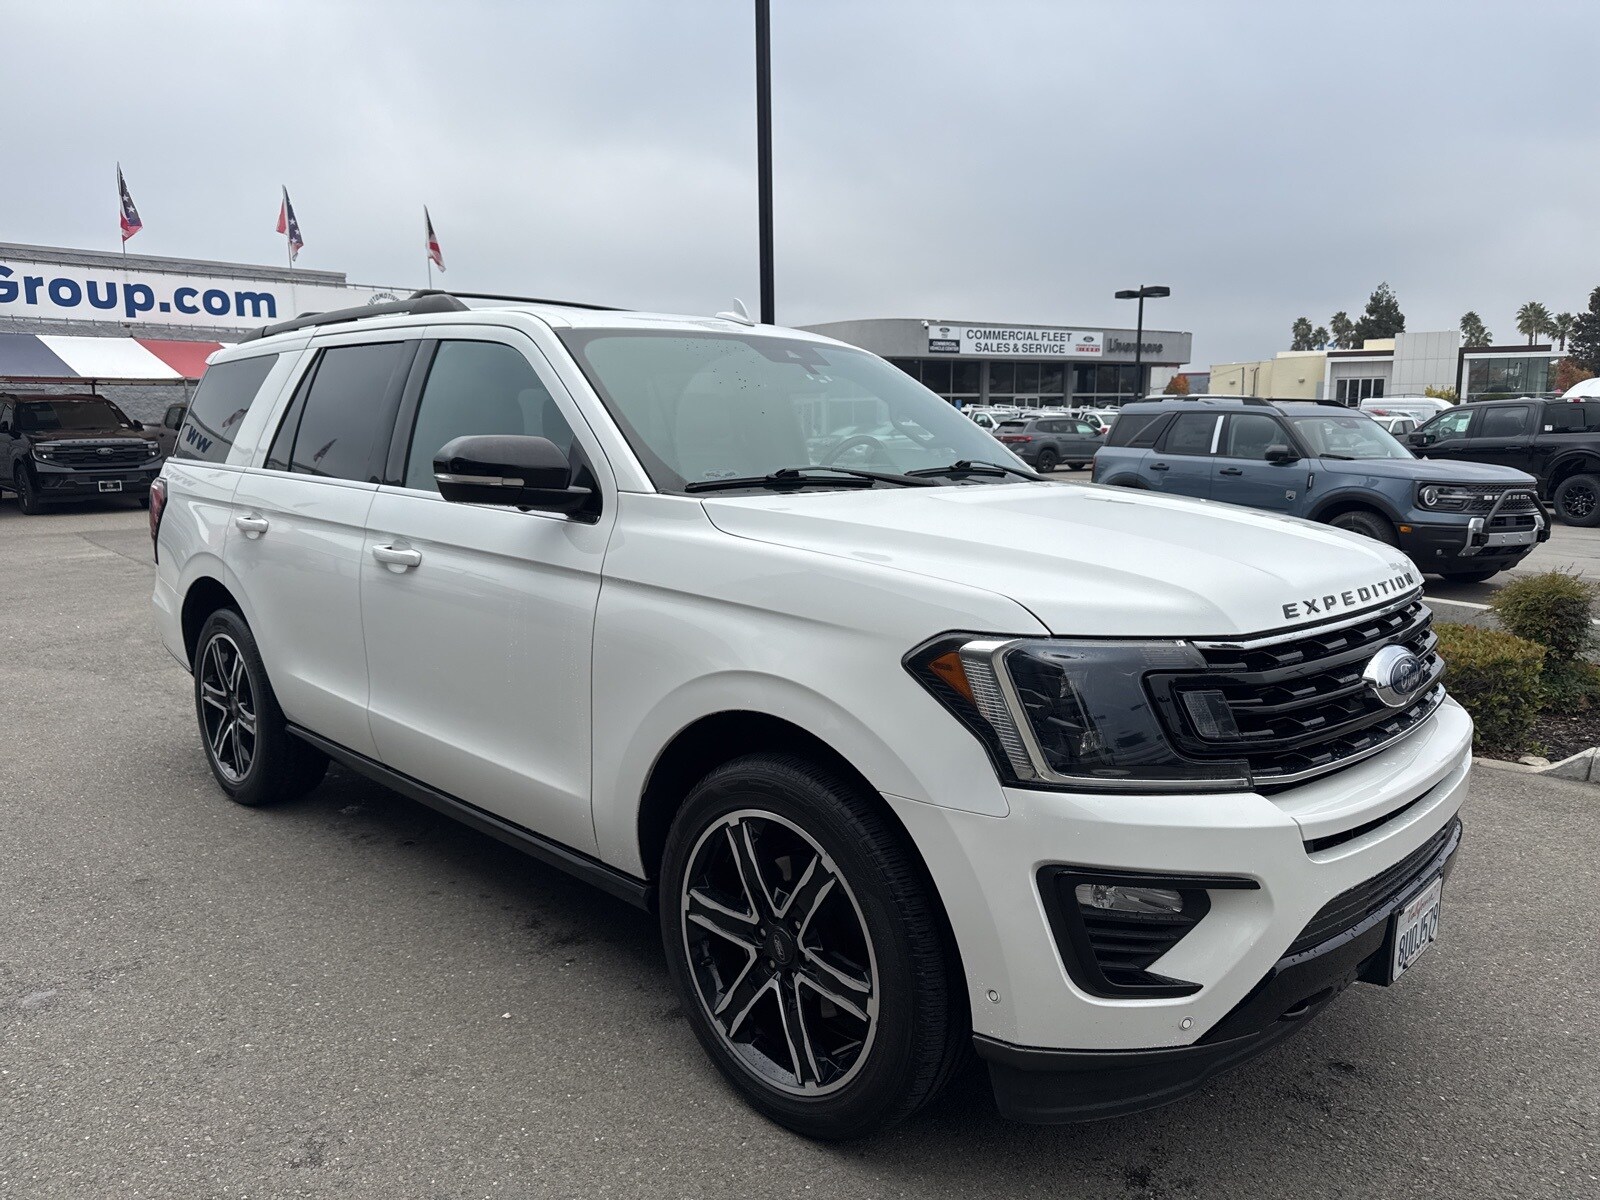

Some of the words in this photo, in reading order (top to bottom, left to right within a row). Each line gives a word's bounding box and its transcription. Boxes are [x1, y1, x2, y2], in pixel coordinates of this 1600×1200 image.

[966, 329, 1039, 341] COMMERCIAL
[1041, 331, 1072, 342] FLEET
[975, 342, 1010, 352] SALES
[1012, 342, 1020, 353] &
[1021, 343, 1065, 353] SERVICE
[1282, 572, 1414, 619] EXPEDITION
